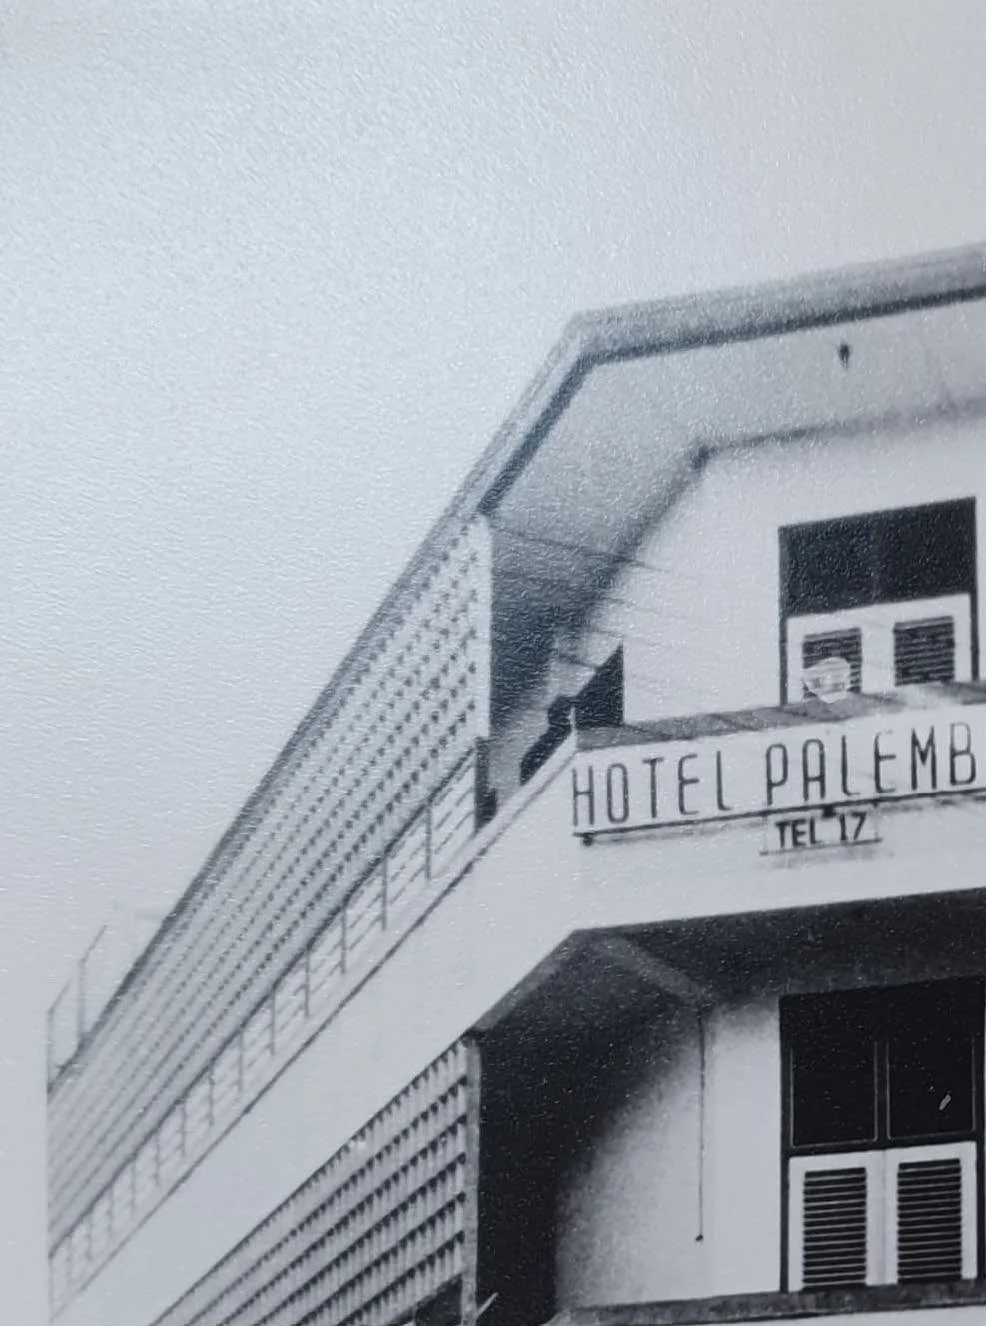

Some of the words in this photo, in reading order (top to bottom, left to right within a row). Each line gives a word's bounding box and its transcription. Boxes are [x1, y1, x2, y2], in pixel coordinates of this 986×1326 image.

[572, 749, 734, 827] HOTEL
[773, 814, 818, 850] TEL
[837, 811, 868, 842] 17
